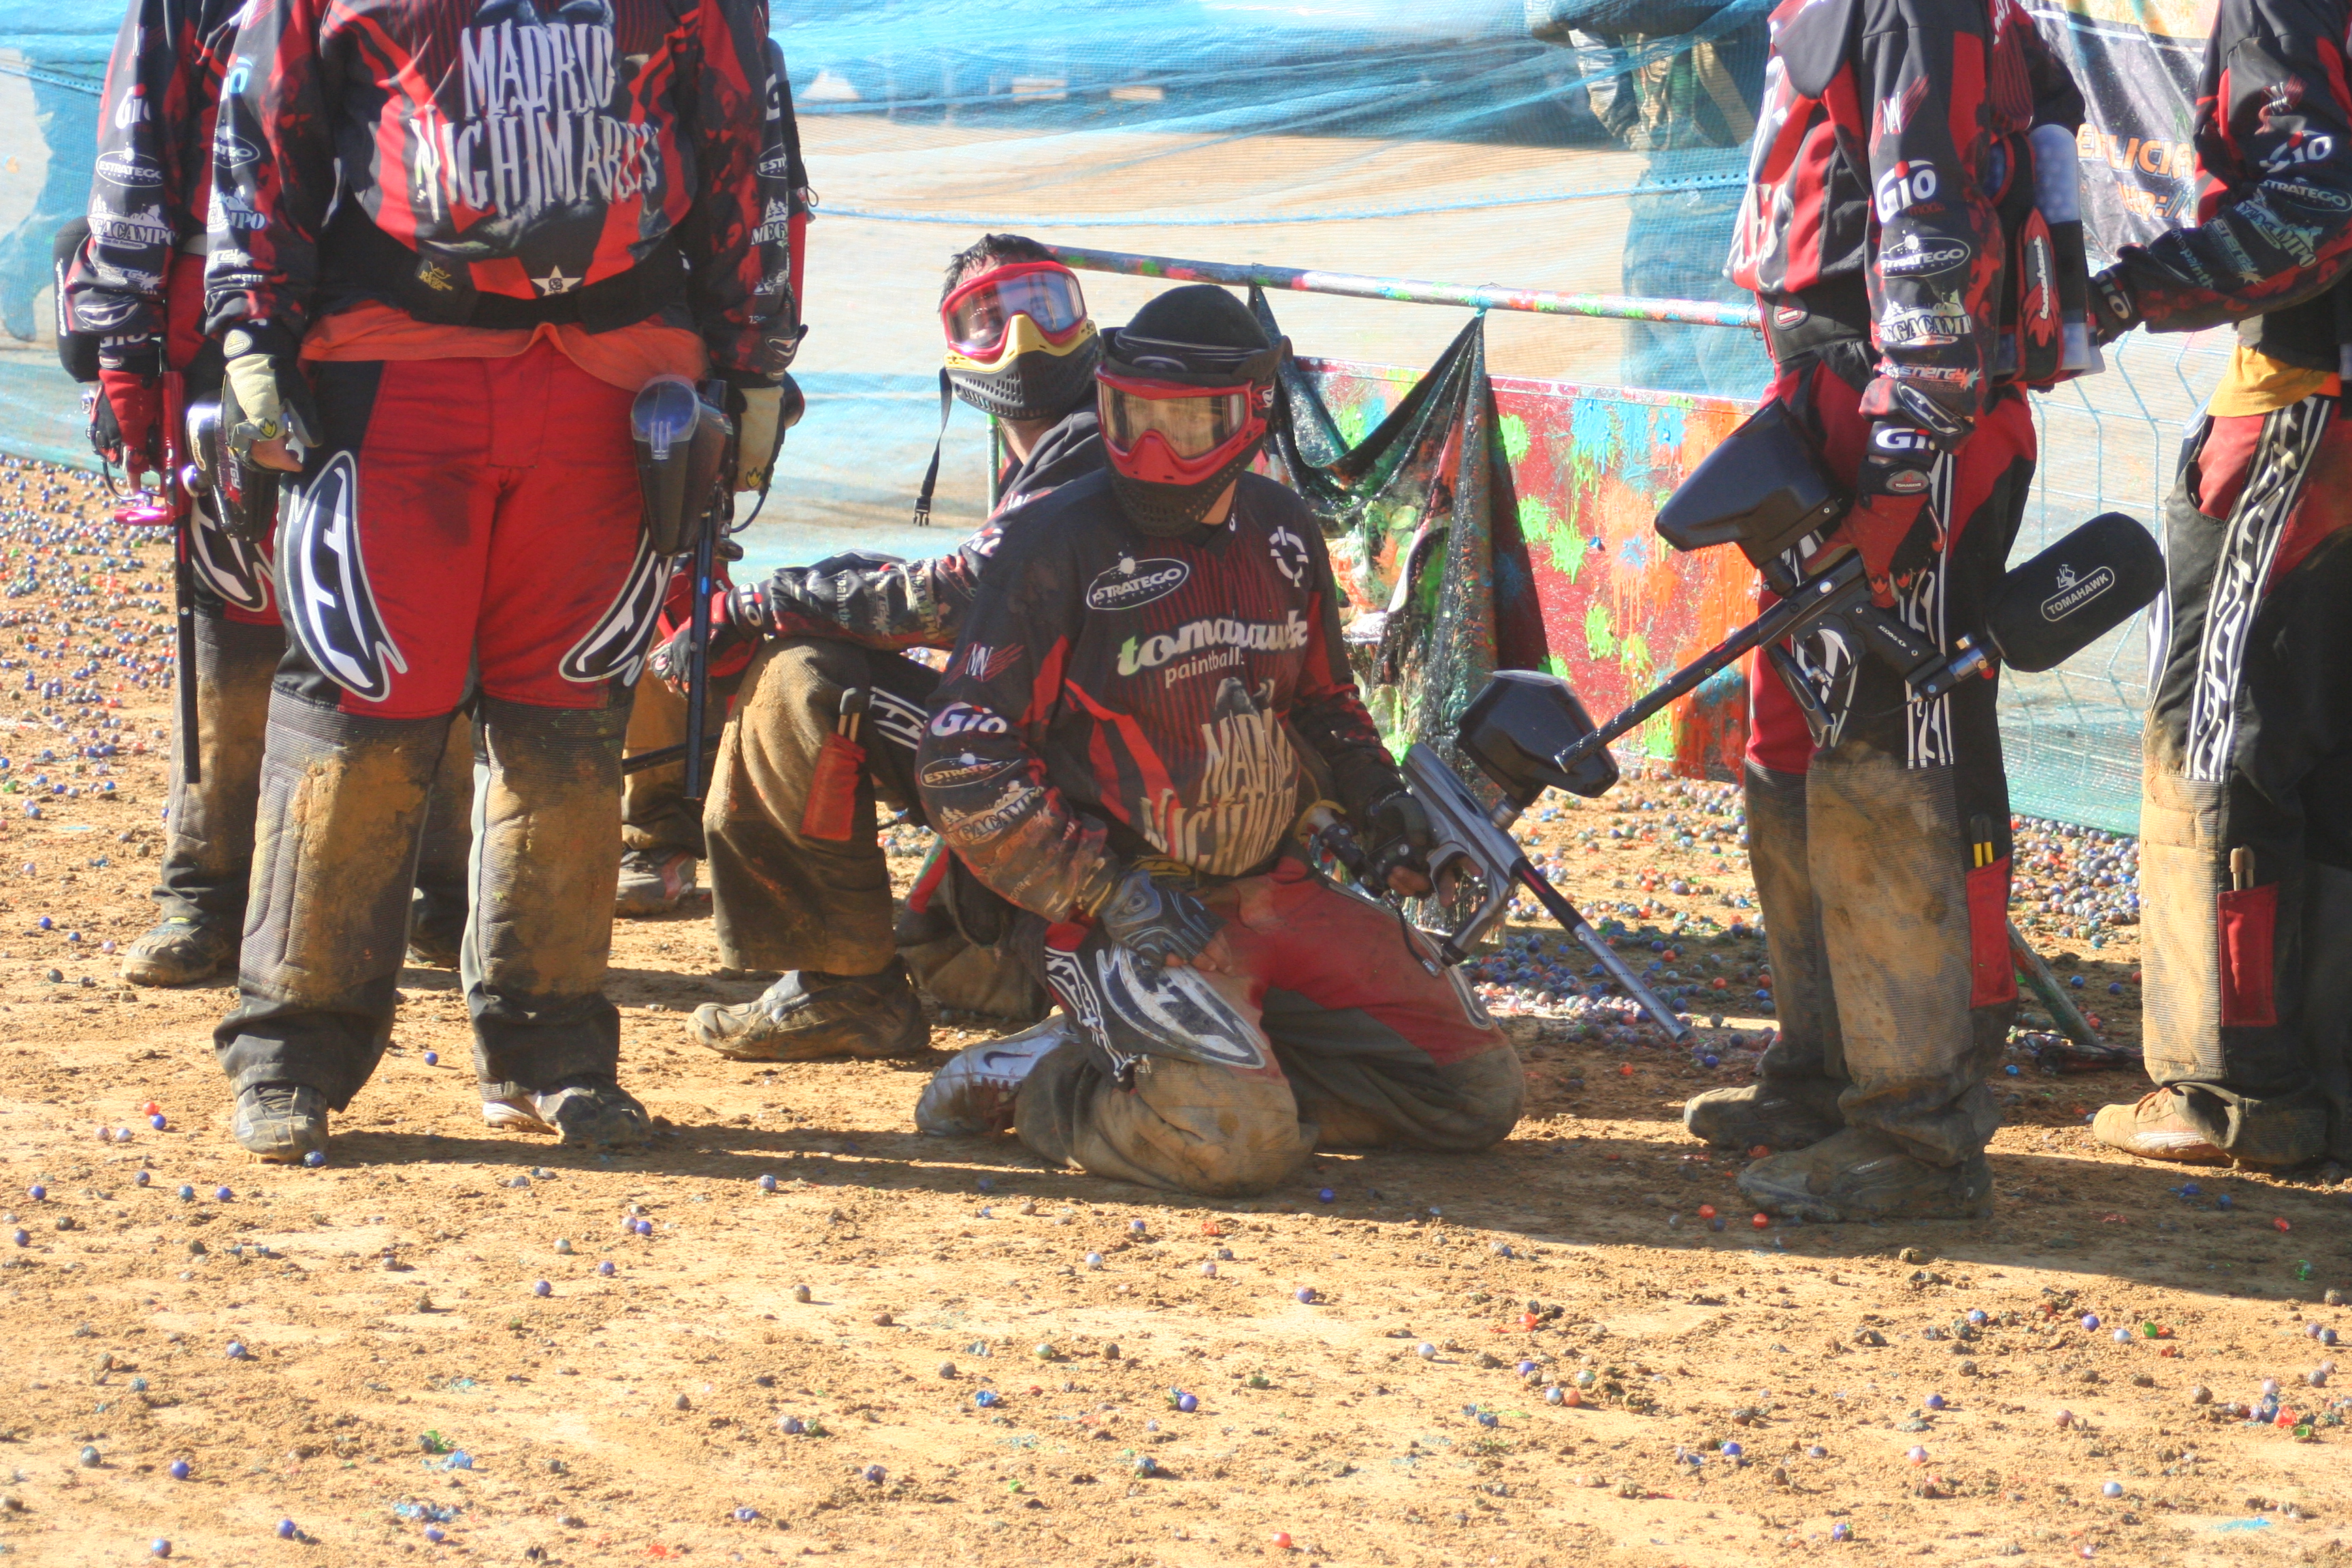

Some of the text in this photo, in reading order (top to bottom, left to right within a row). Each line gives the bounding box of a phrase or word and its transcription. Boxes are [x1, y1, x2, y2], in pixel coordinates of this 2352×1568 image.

[461, 18, 616, 121] MADRID
[1876, 160, 1937, 223] Gio
[1880, 248, 1965, 270] STRATEGO
[2034, 235, 2049, 319] tomahawk
[2046, 573, 2109, 615] TOMAHAWK
[930, 701, 1007, 737] Gio
